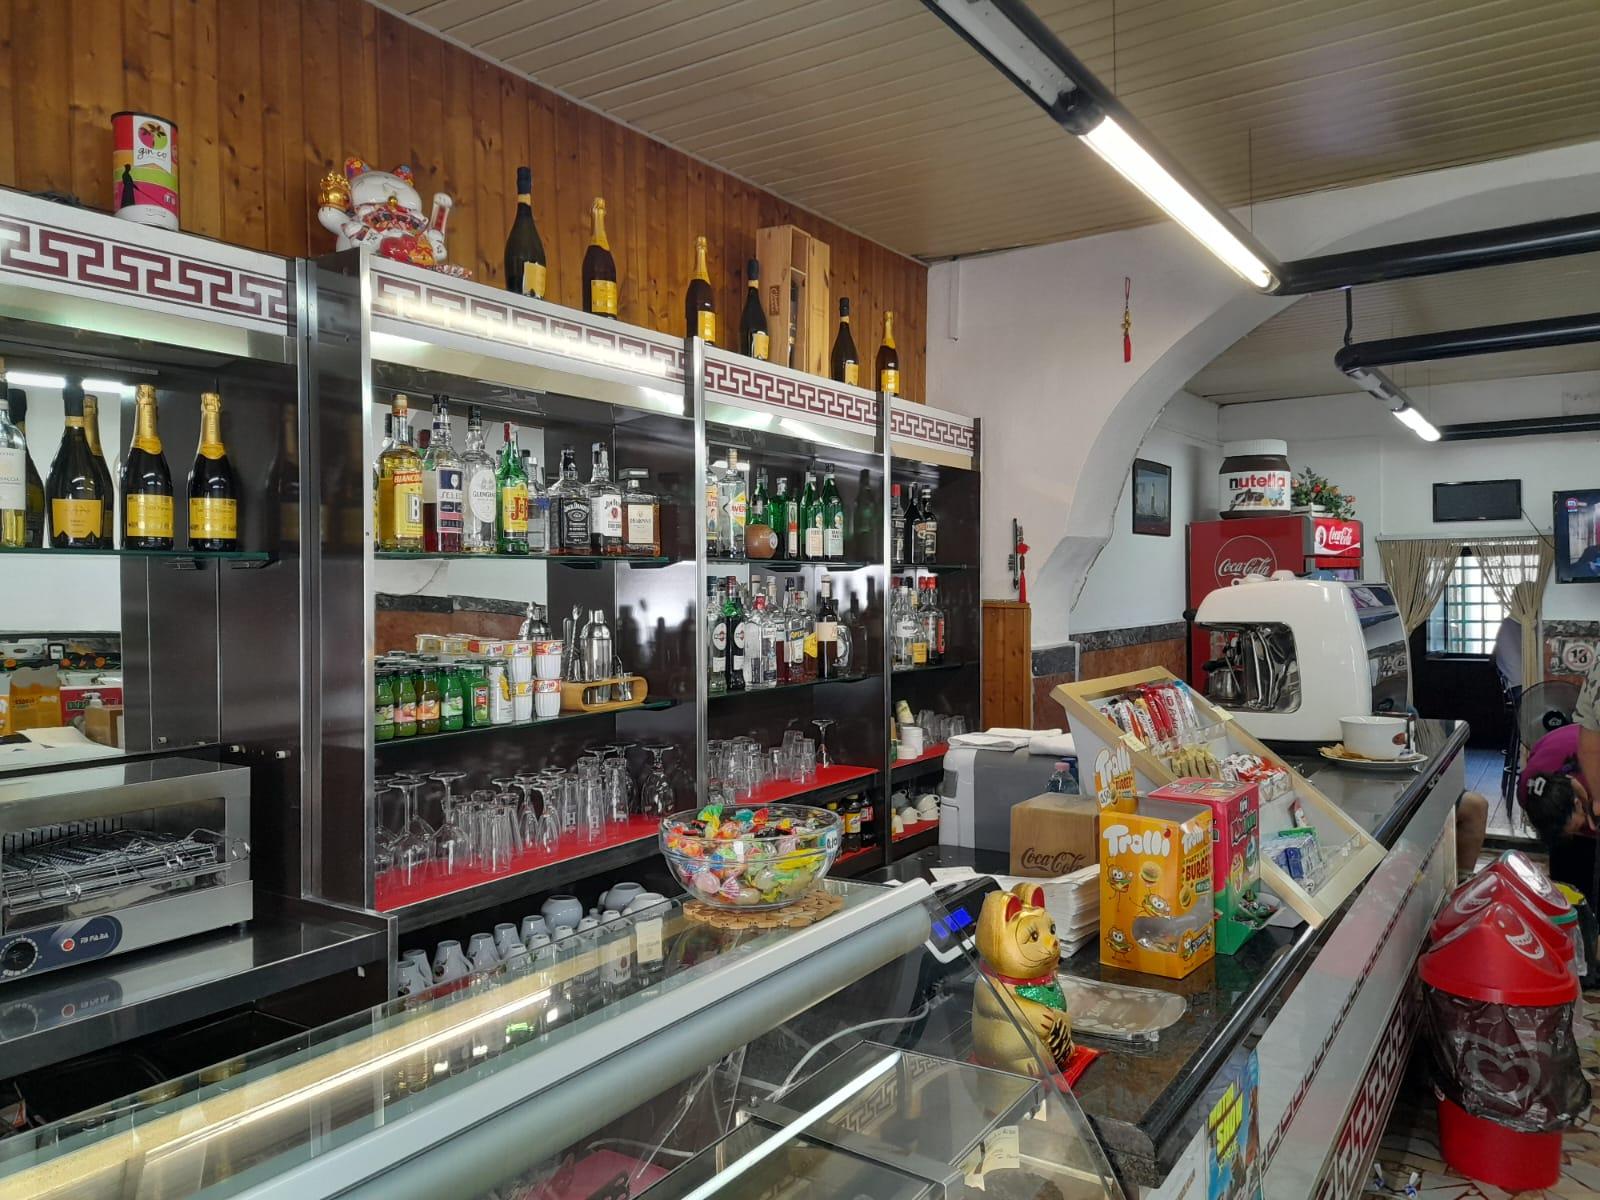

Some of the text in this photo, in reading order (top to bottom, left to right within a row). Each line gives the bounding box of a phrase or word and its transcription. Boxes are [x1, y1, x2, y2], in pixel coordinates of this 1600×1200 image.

[1230, 473, 1286, 490] nutella
[1218, 558, 1272, 576] Coca-Cola
[1103, 825, 1170, 858] Trolli
